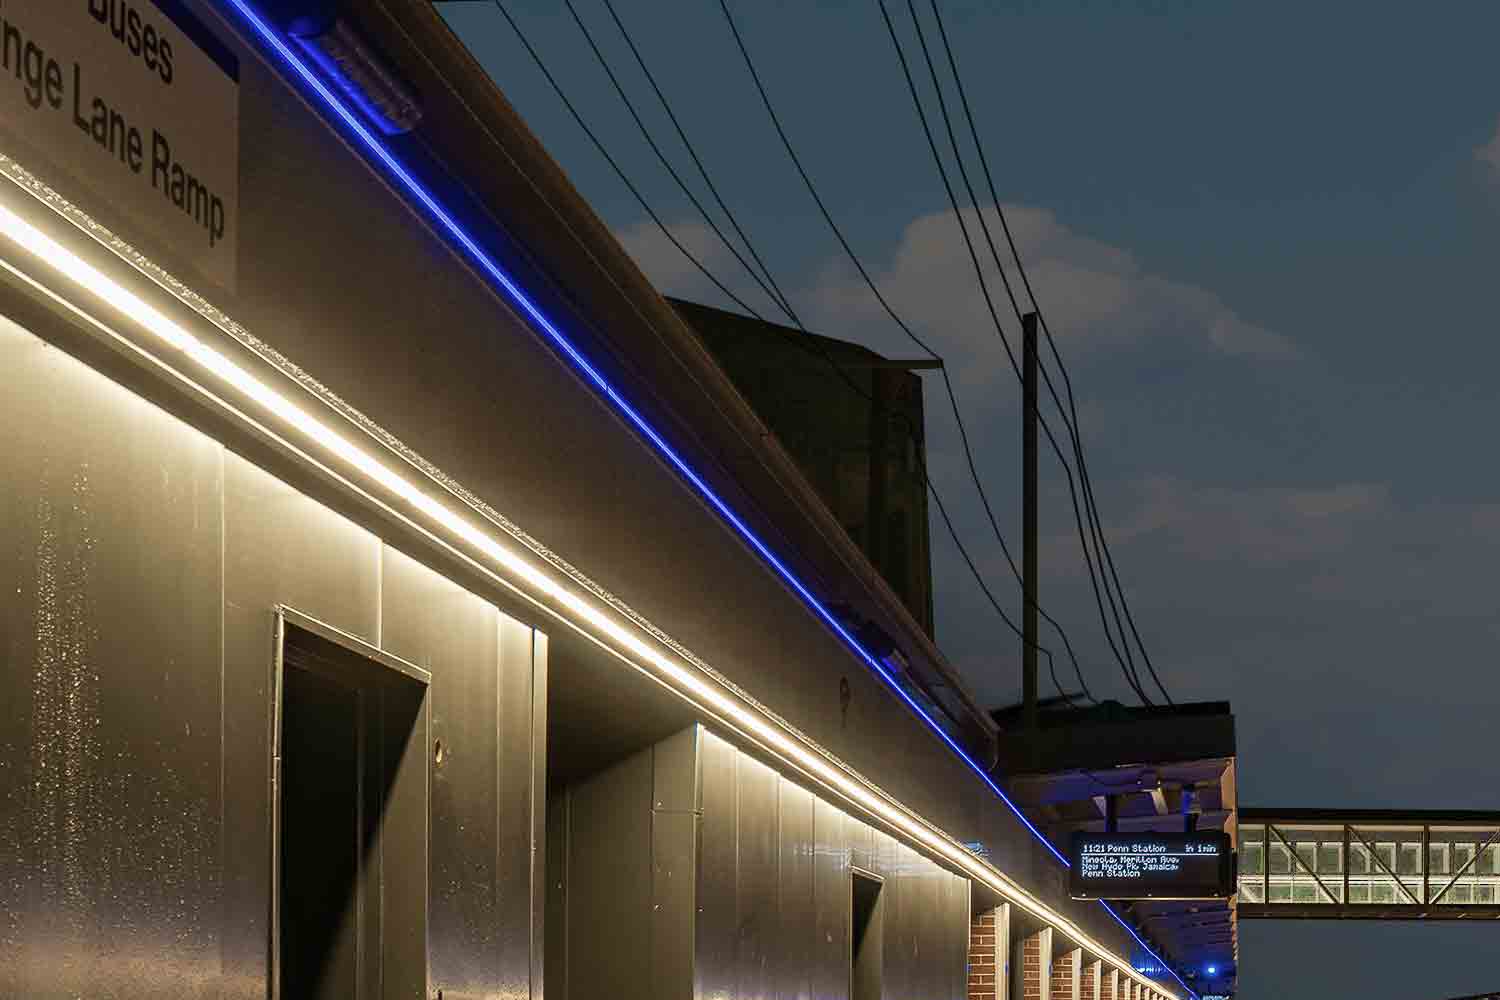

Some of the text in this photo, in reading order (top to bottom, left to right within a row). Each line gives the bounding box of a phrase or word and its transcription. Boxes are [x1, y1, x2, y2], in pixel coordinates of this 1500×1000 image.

[72, 62, 143, 174] Lane
[151, 128, 225, 248] Ramp
[1107, 844, 1129, 853] Penn
[1132, 844, 1166, 853] Station
[1082, 869, 1141, 878] Penn Station
